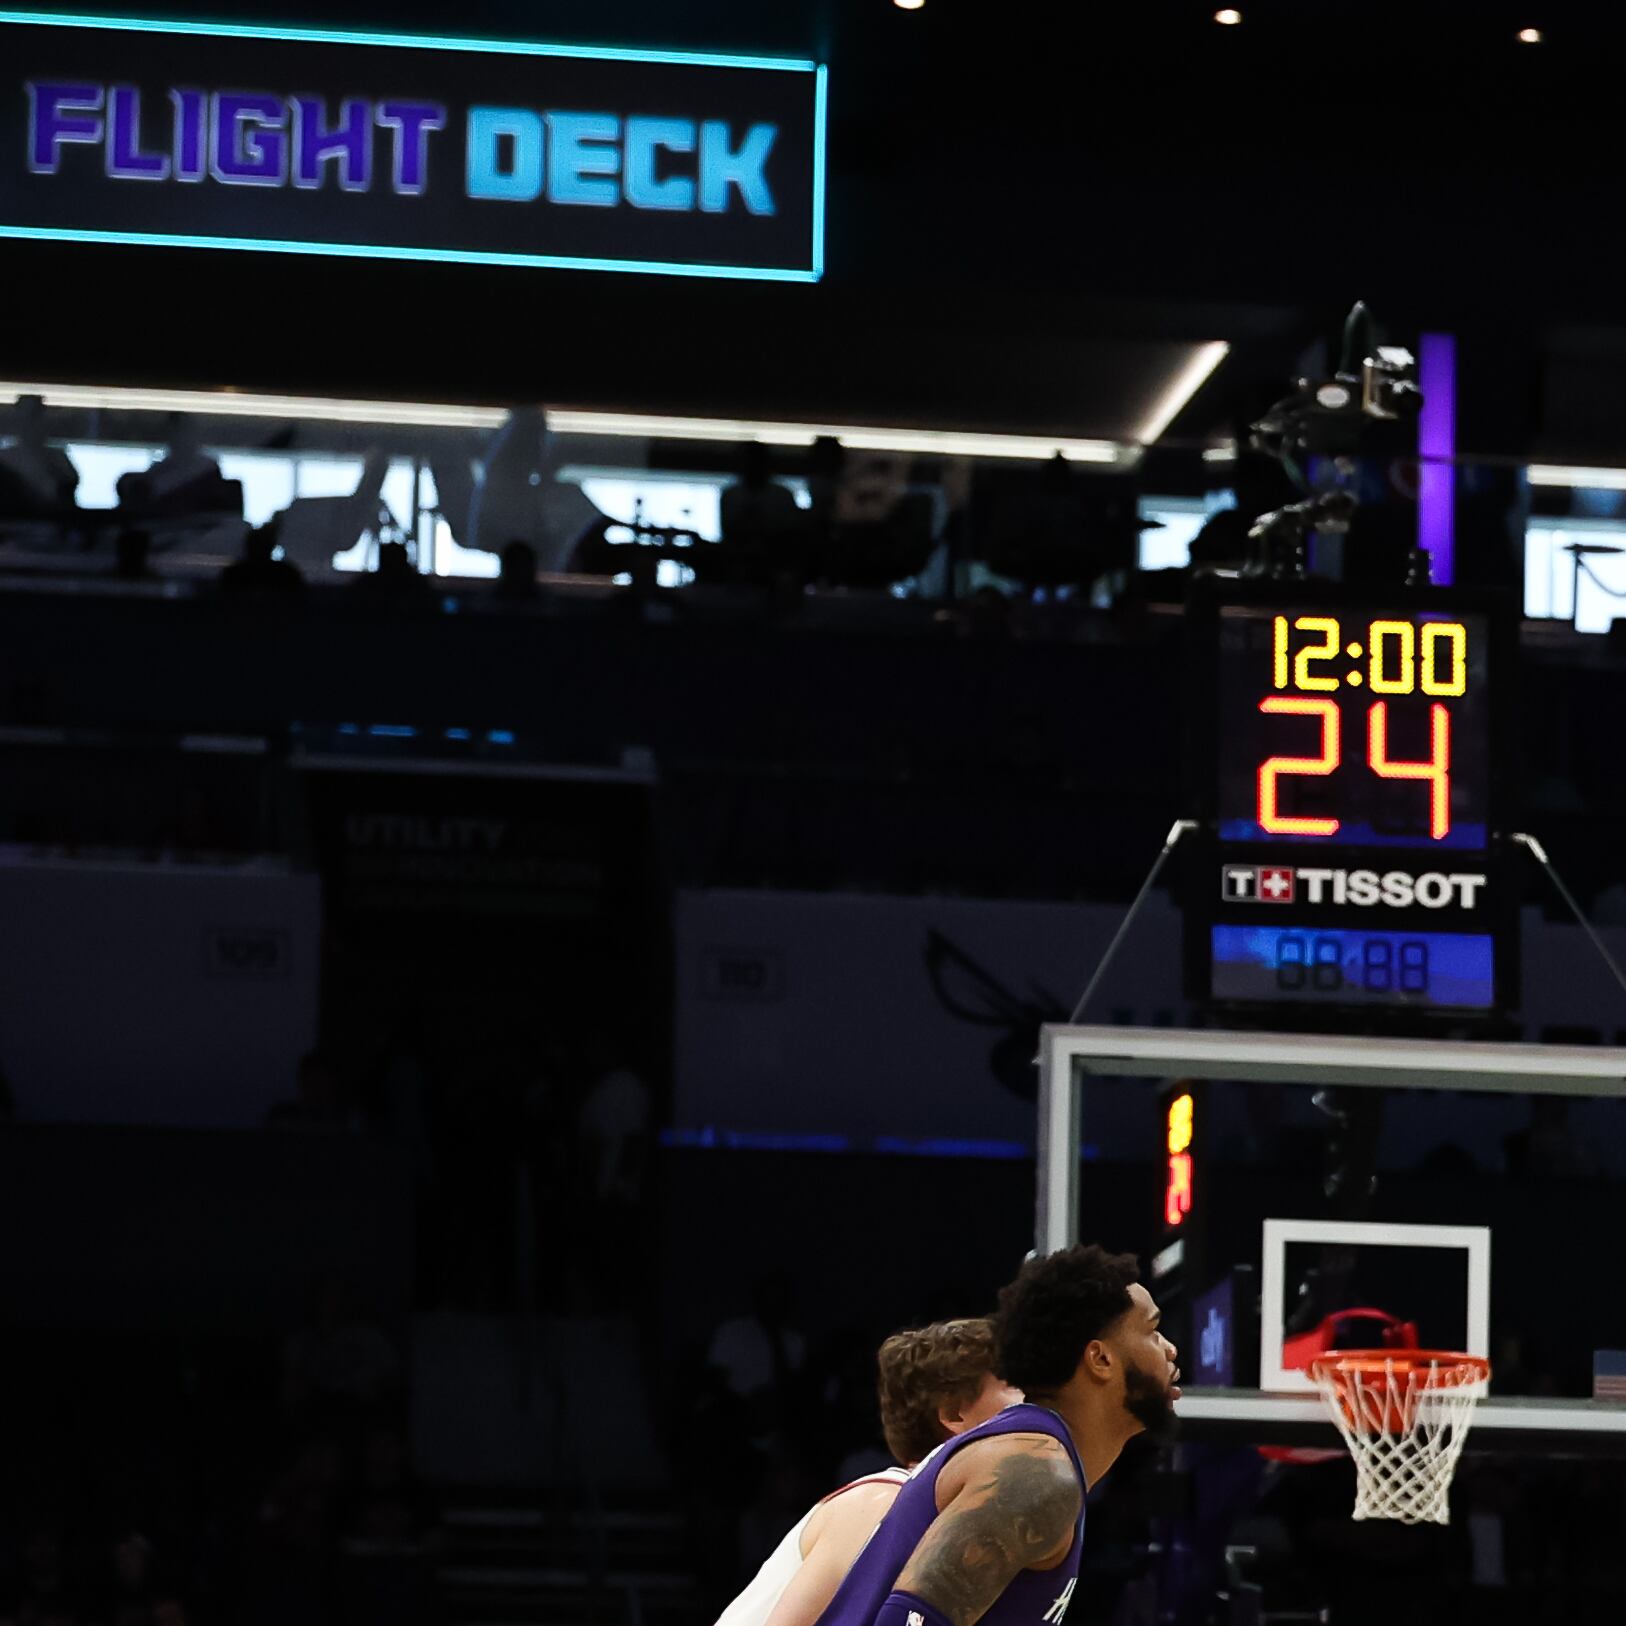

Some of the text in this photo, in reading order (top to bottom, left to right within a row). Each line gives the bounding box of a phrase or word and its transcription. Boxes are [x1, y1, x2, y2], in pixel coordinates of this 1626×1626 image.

[26, 82, 779, 216] FLIGHT DECK
[1272, 615, 1466, 697] 12:00
[1256, 695, 1450, 840] 24
[1296, 867, 1487, 909] TISSOT
